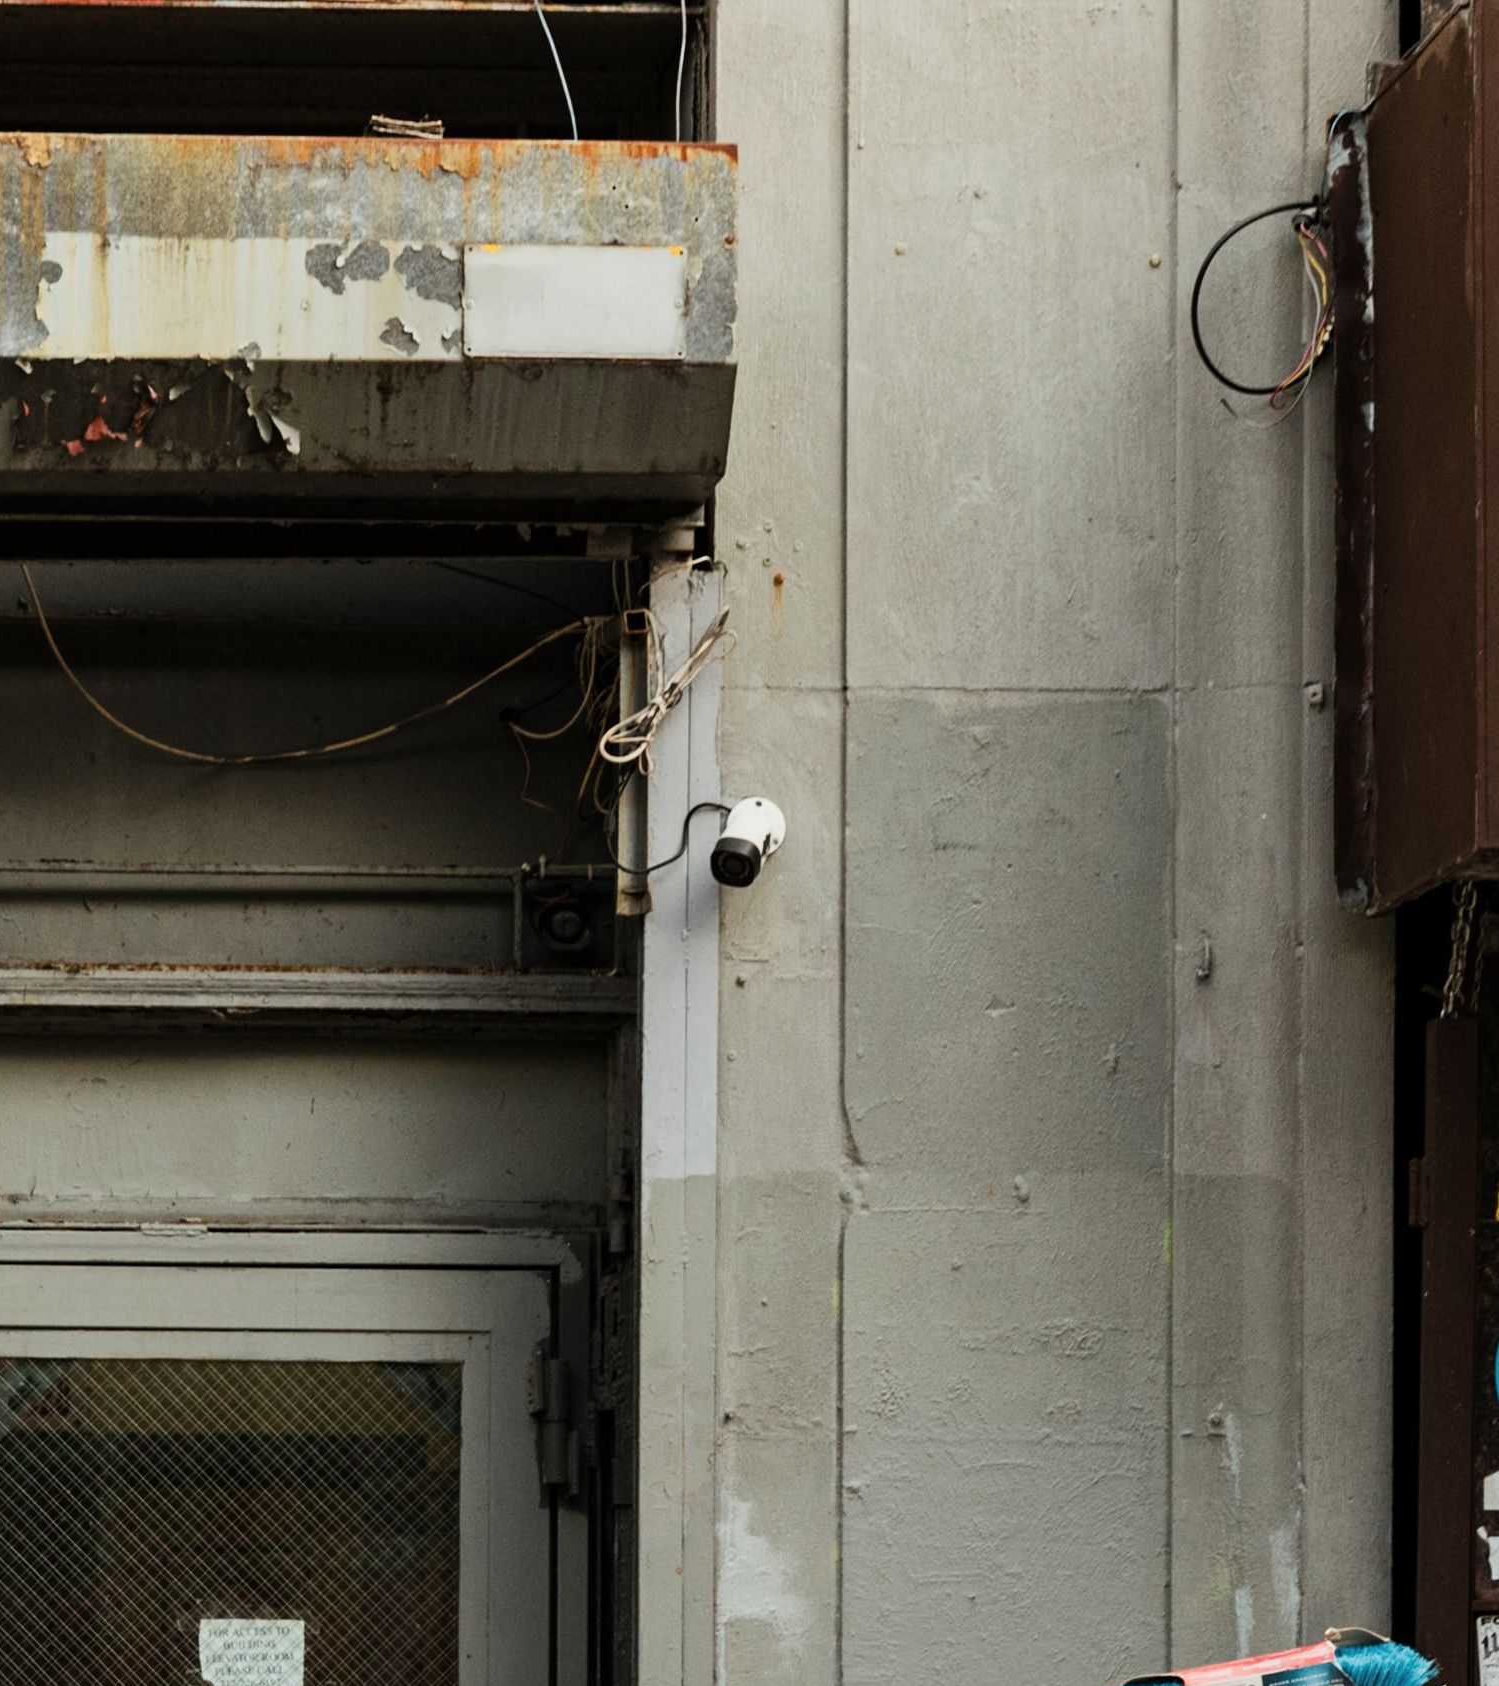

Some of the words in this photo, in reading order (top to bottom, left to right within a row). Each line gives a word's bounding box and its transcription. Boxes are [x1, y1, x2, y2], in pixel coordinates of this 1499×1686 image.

[233, 1626, 273, 1637] ACCESS
[275, 1626, 290, 1636] TO
[223, 1640, 276, 1650] BUILDING
[262, 1652, 294, 1661] ROOM
[214, 1666, 253, 1676] PLEASE
[257, 1665, 282, 1675] CALL
